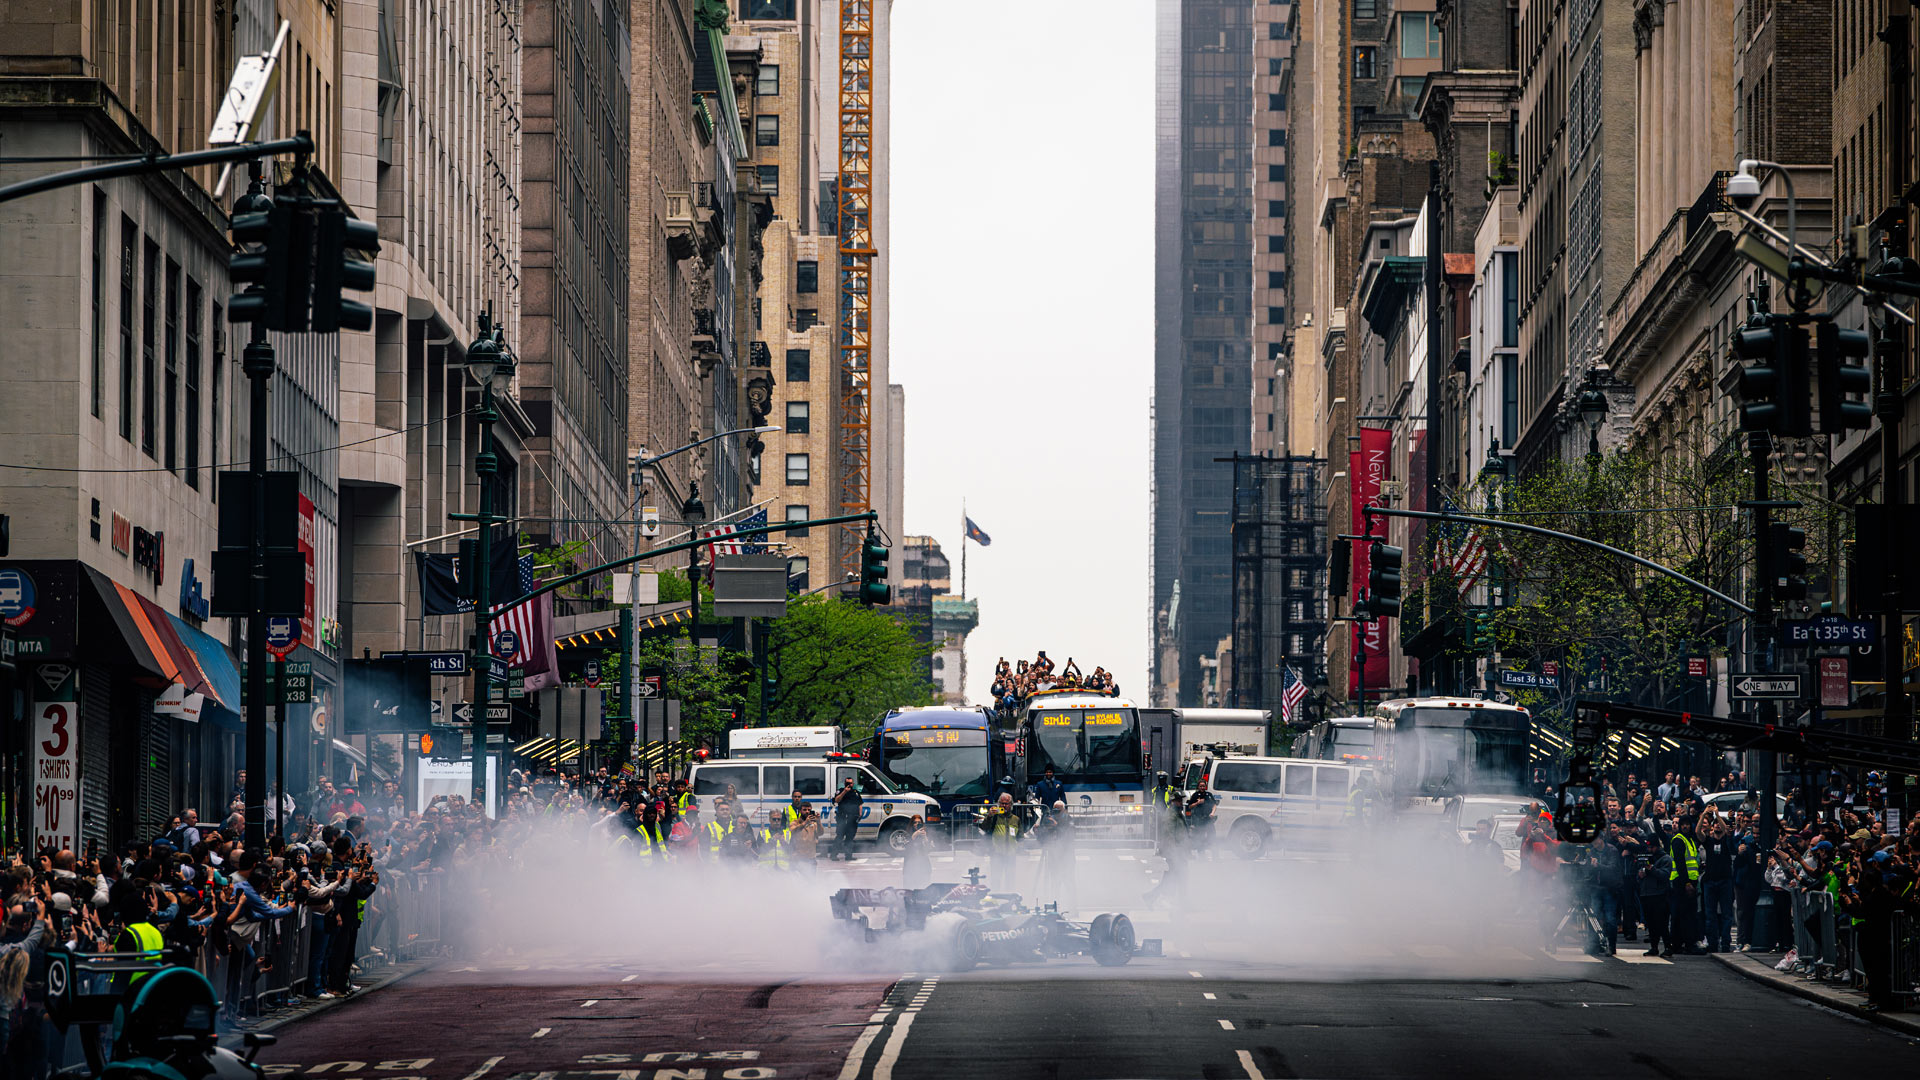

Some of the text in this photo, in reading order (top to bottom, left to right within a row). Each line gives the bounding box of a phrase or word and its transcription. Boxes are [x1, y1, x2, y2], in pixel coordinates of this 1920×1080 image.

[1369, 450, 1384, 486] New
[1792, 625, 1867, 640] Eat 35th St
[18, 640, 44, 653] MTA
[448, 657, 462, 669] St
[286, 677, 306, 688] x28
[1506, 673, 1525, 683] East
[1526, 674, 1544, 685] 36h
[1743, 682, 1790, 691] ONE WAY
[286, 690, 306, 702] x38
[462, 708, 505, 718] ON WAY
[42, 704, 69, 756] 3
[937, 731, 944, 743] 5
[946, 731, 960, 744] AV
[39, 759, 71, 779] T-SHIRTS
